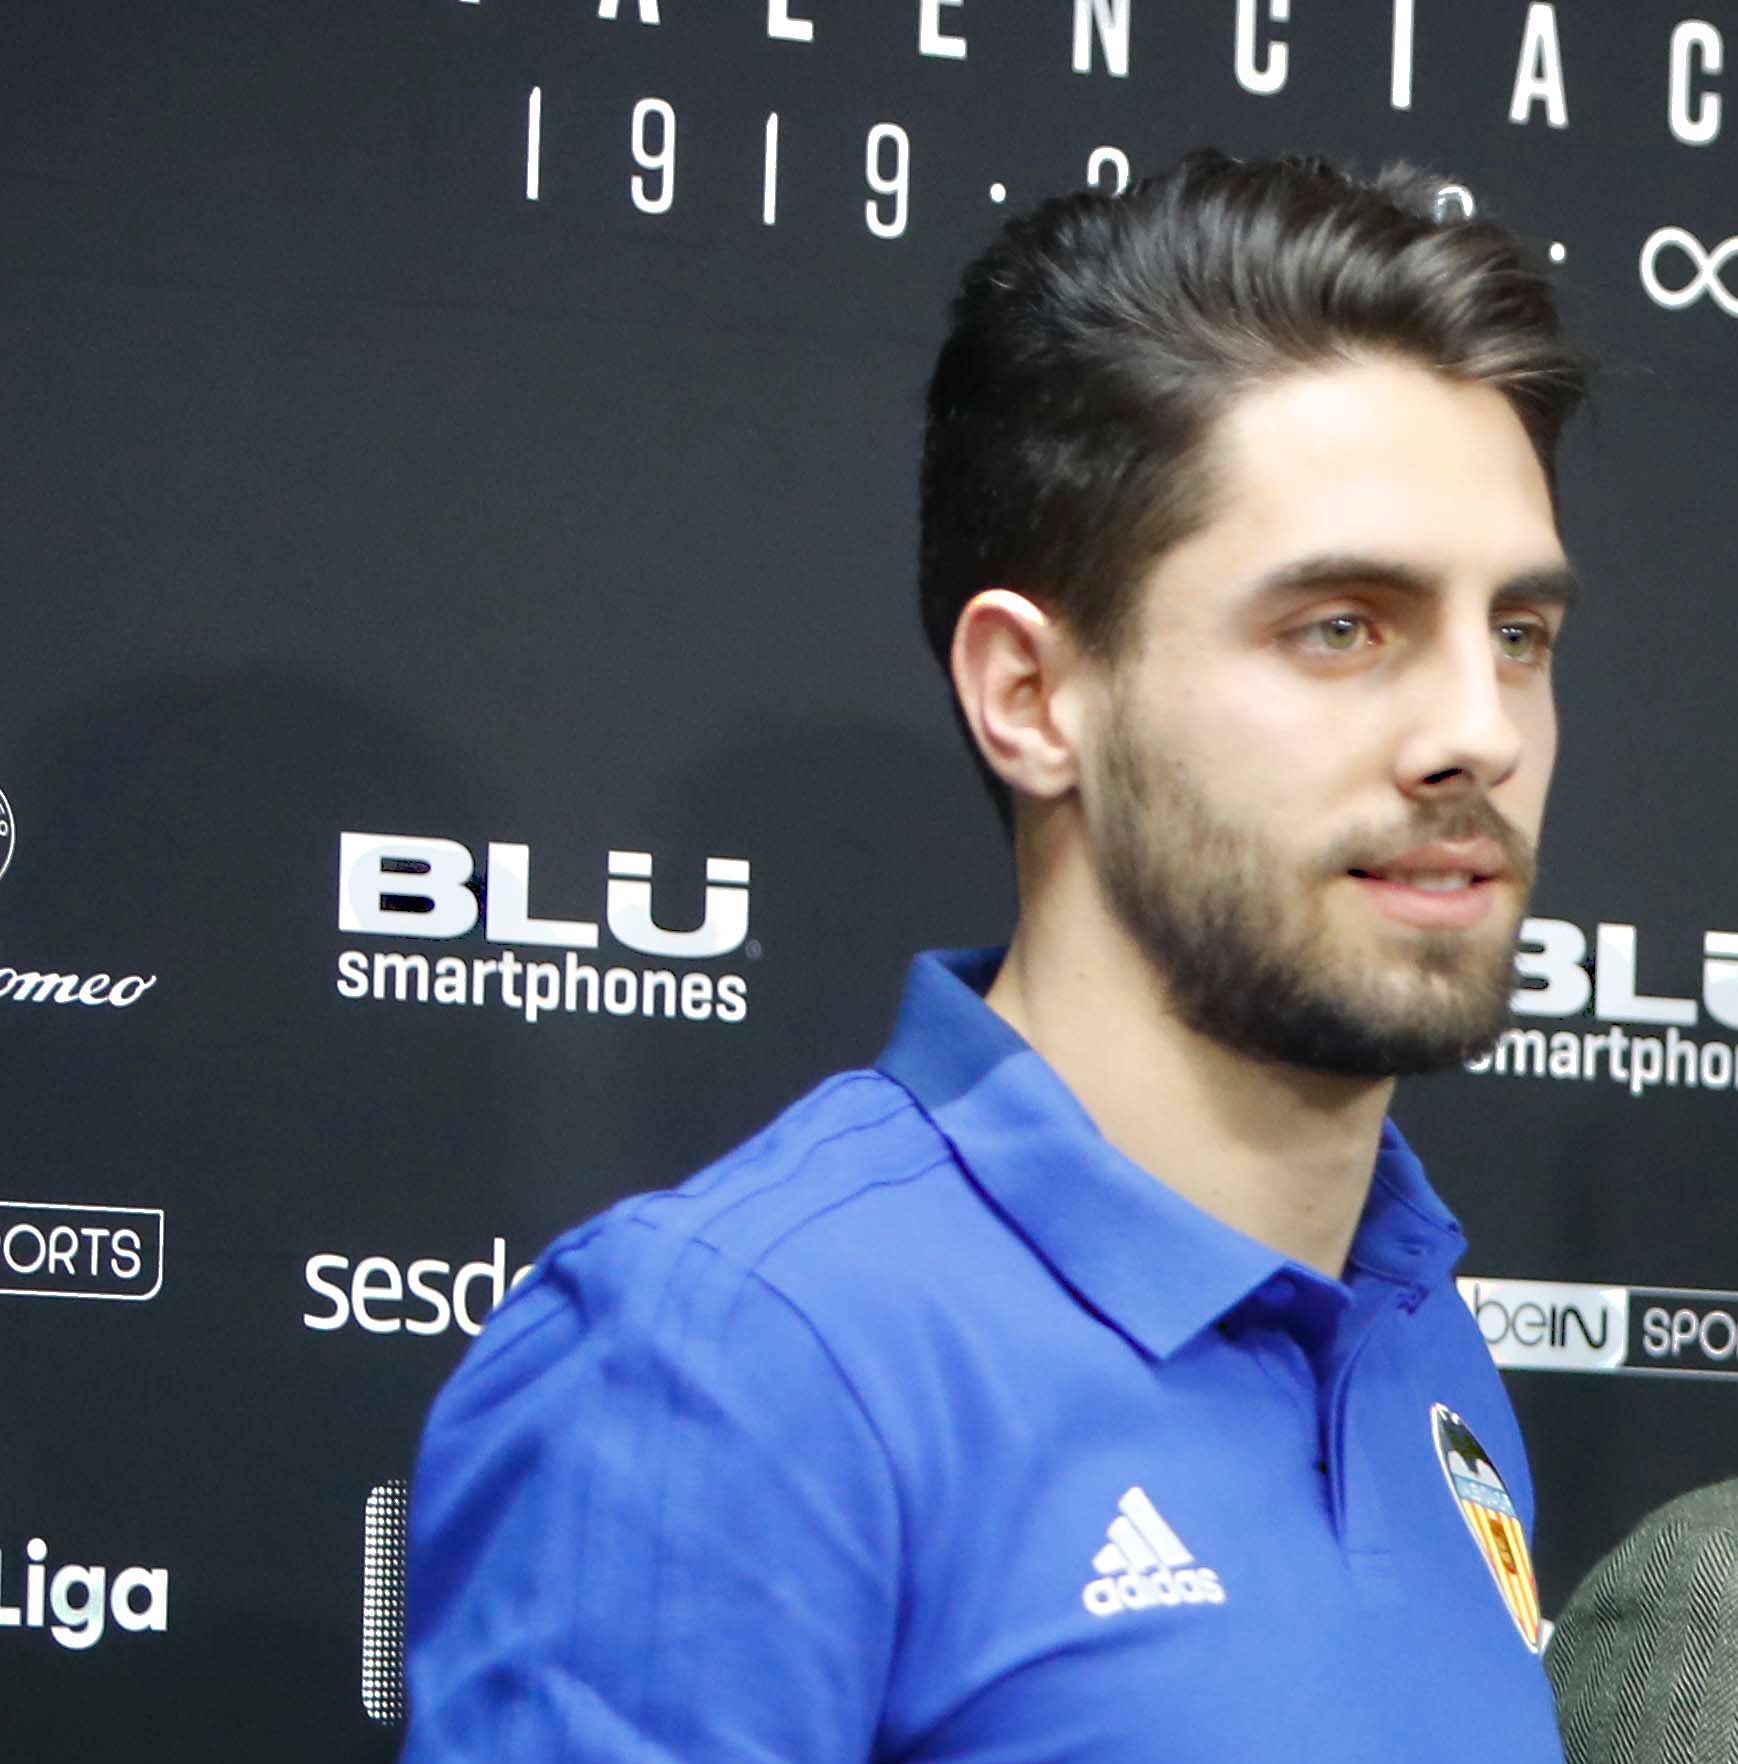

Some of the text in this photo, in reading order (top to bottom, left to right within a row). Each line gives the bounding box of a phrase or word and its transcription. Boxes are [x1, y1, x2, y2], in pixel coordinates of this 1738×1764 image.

[337, 949, 748, 1024] smartphones
[303, 1237, 535, 1337] sesd
[1082, 1566, 1227, 1617] adidas
